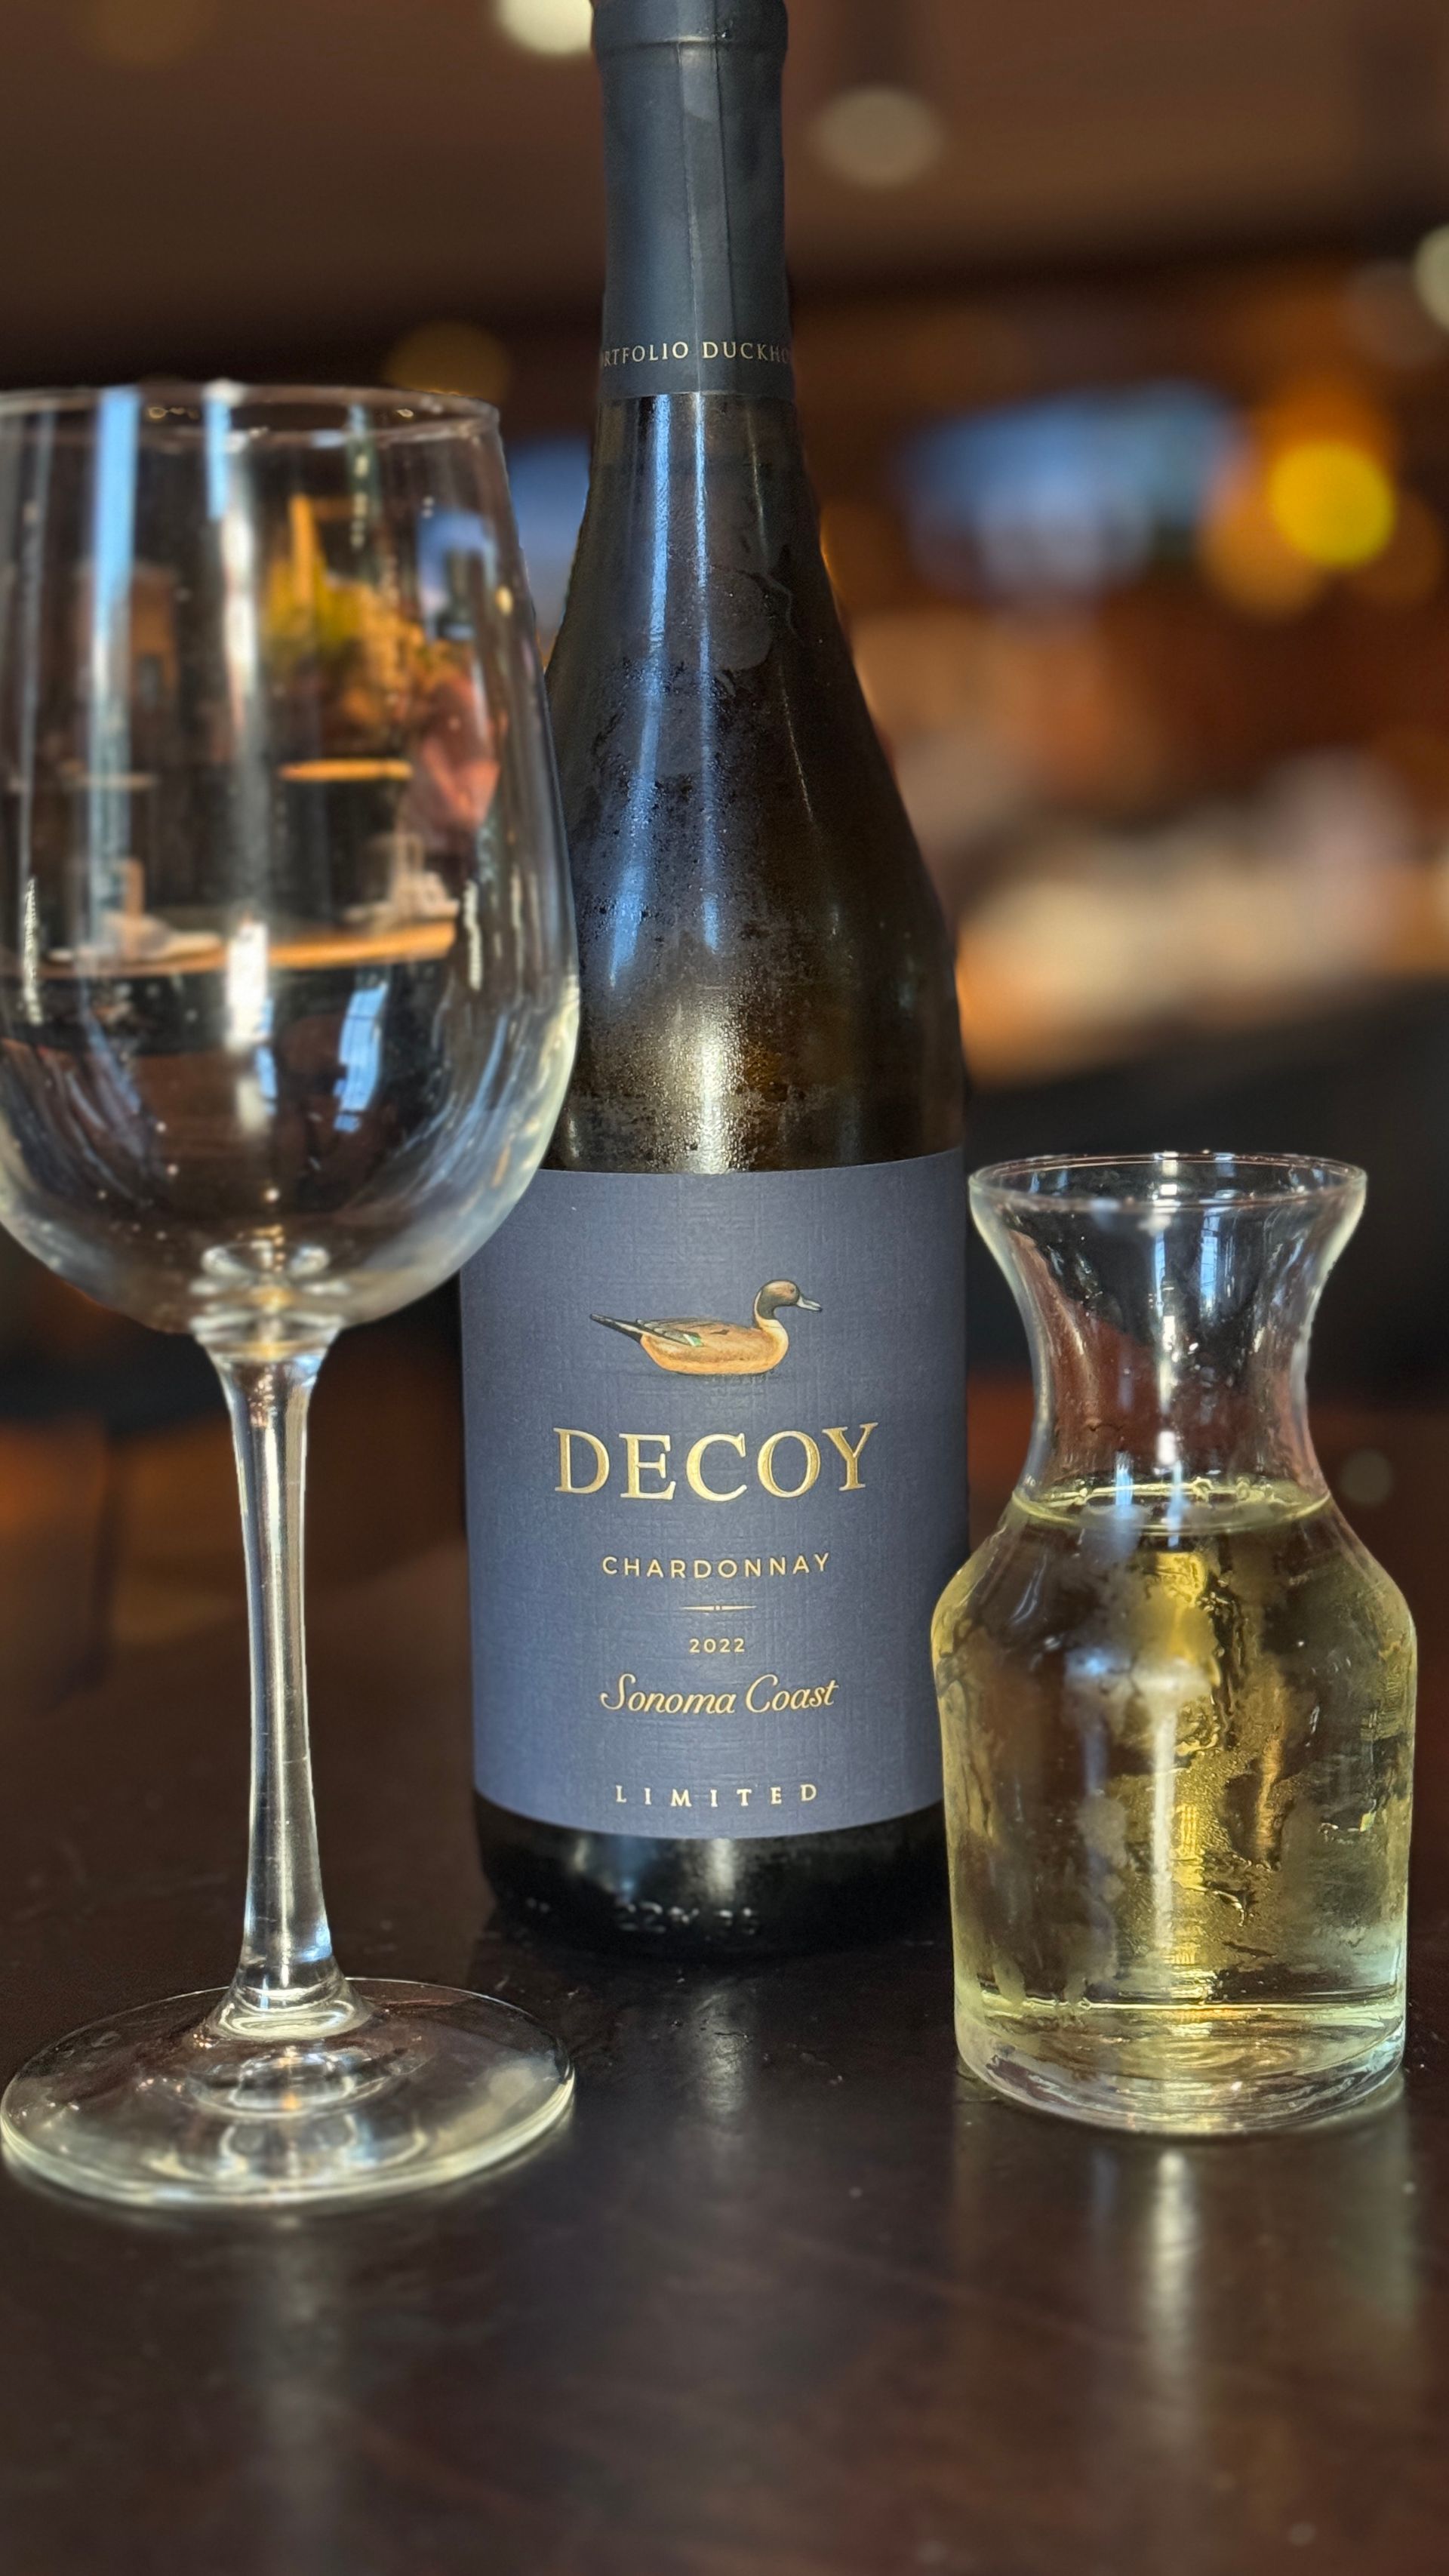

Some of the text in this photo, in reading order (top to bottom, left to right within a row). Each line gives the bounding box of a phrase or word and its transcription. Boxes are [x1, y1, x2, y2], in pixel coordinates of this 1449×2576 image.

[553, 1422, 878, 1502] DECOY
[602, 1553, 830, 1579] CHARDONNAY
[689, 1638, 746, 1653] 2022
[600, 1673, 840, 1714] Sonoma Coast
[615, 1784, 818, 1808] LIMITED
